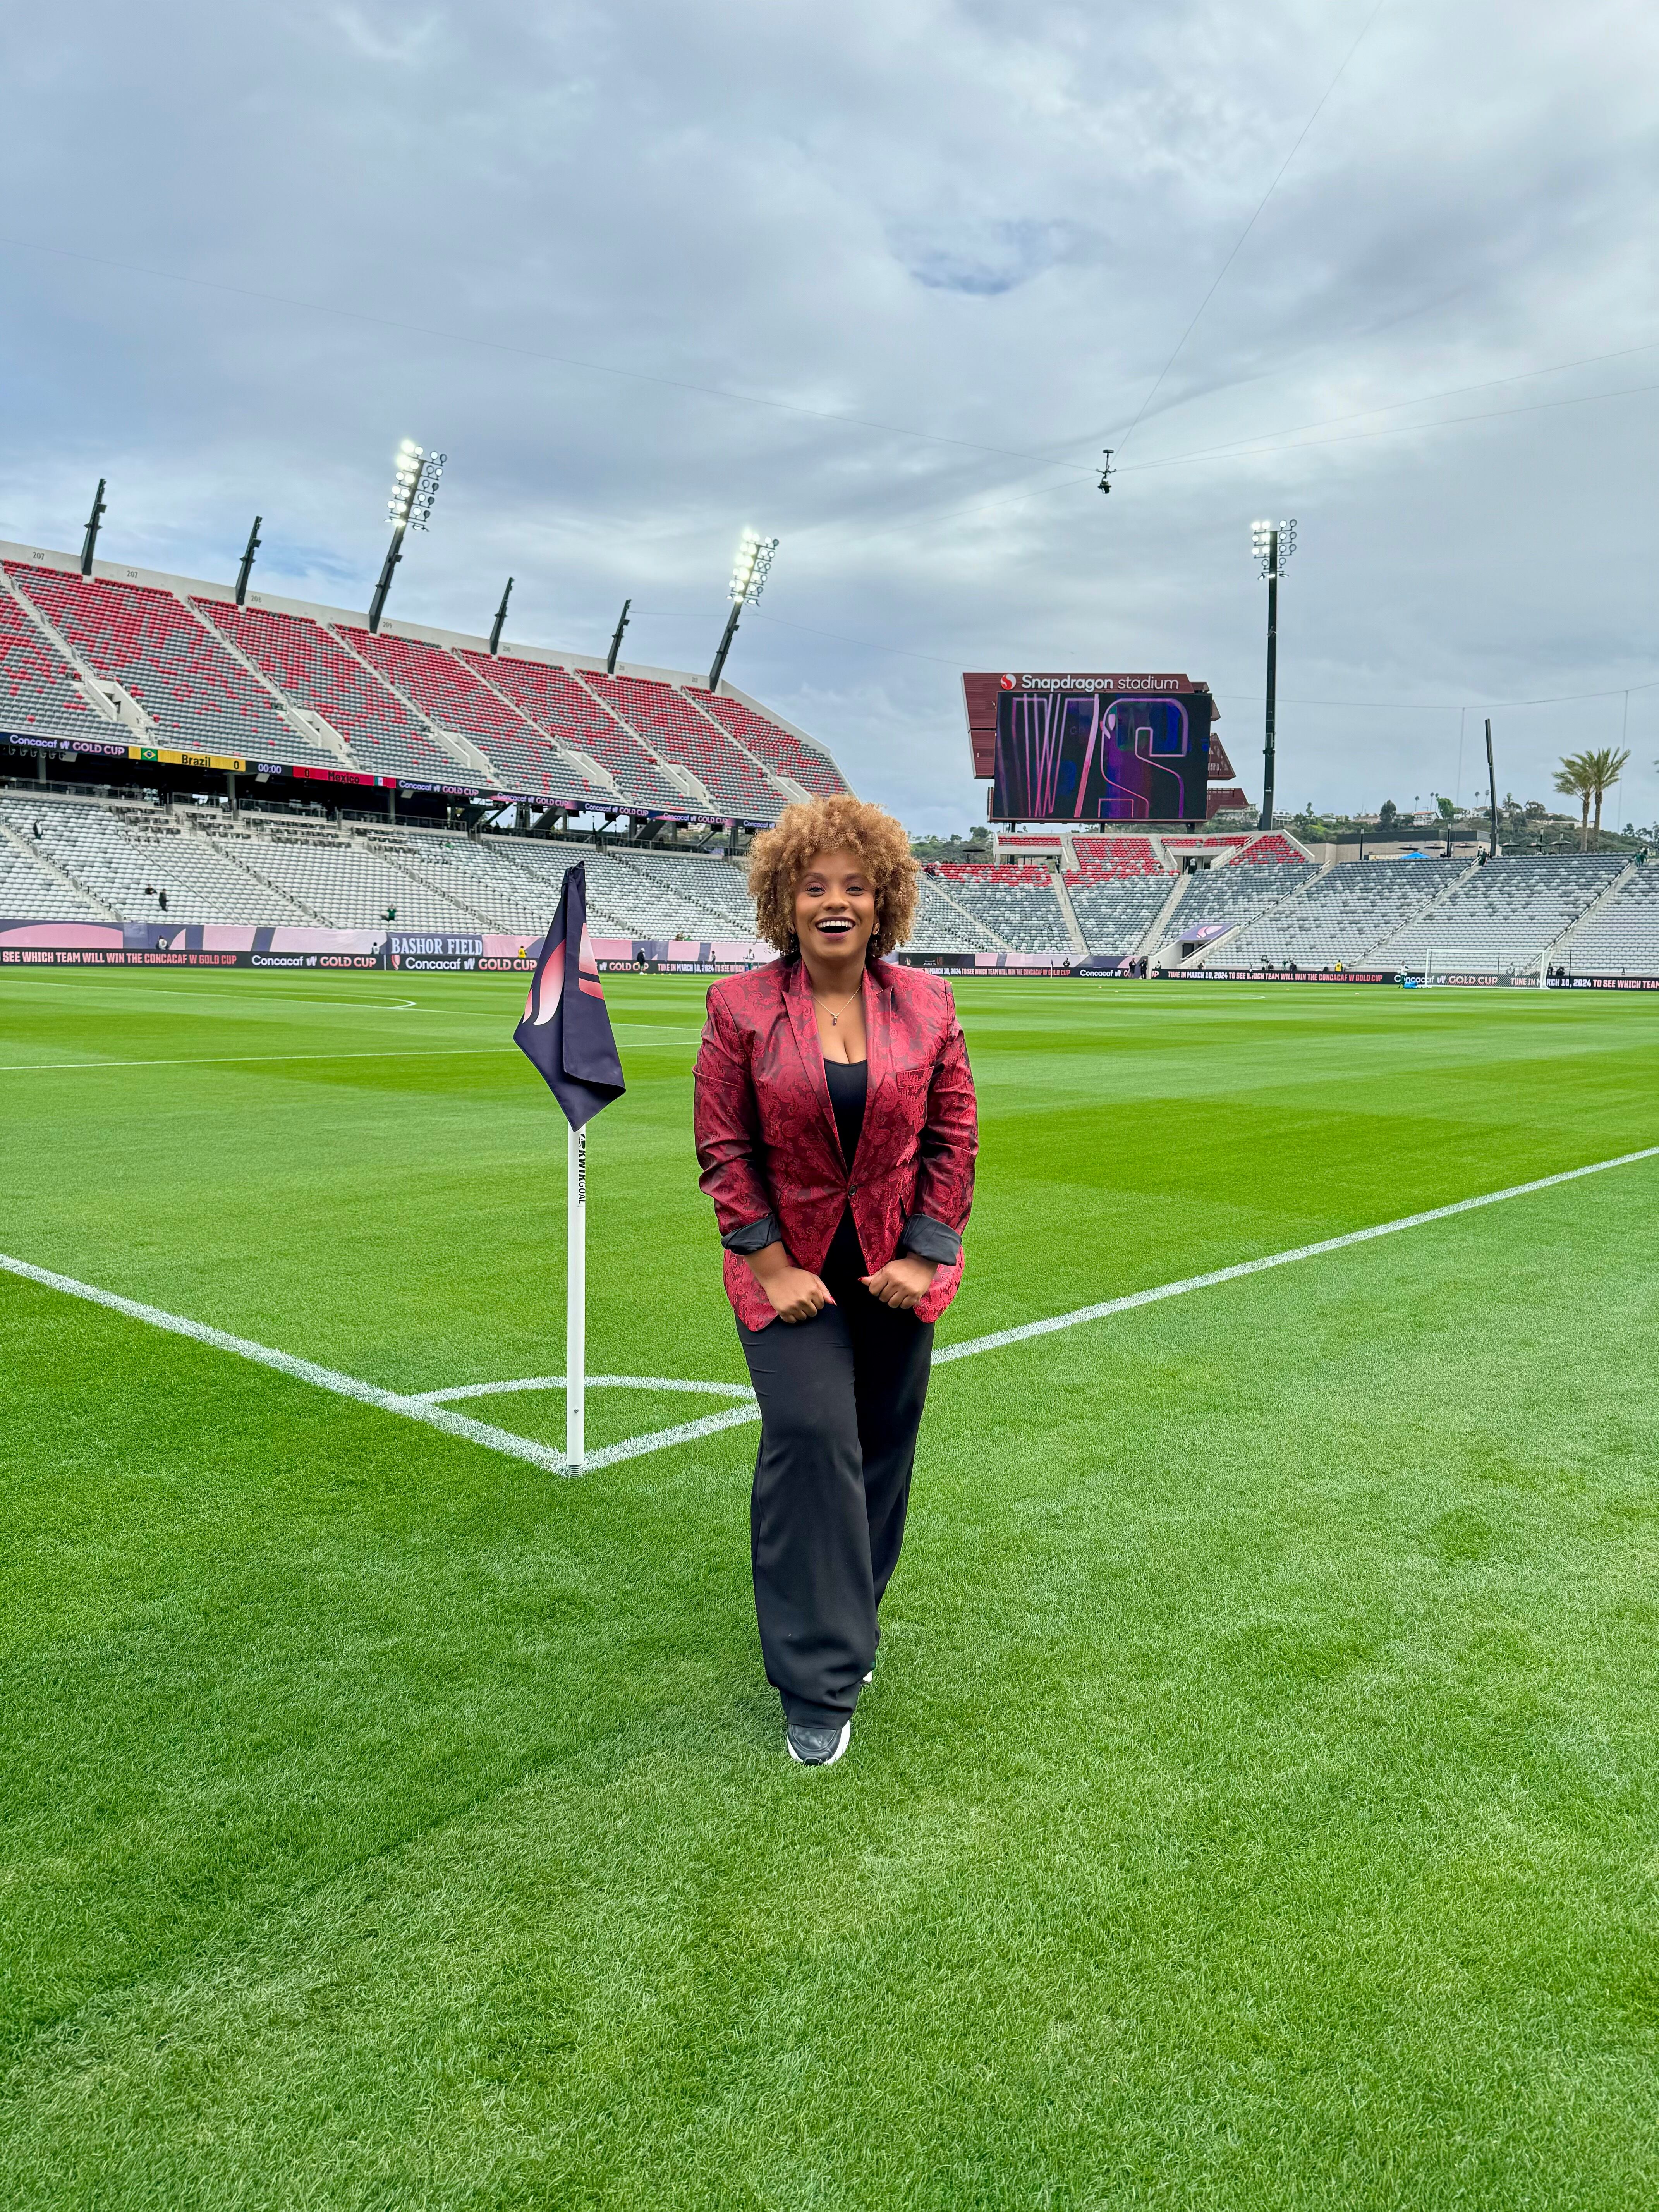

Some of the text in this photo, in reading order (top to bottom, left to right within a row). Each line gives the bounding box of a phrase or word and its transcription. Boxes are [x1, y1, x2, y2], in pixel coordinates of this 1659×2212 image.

[33, 551, 45, 560] 207
[126, 570, 138, 579] 207
[1021, 675, 1179, 692] Snapdragon stadium
[10, 734, 58, 748] Concacaf
[72, 742, 102, 754] GOLD
[103, 745, 125, 756] CUP
[182, 754, 211, 767] Brazil
[234, 760, 239, 769] 0
[258, 763, 282, 774] 00:00
[328, 771, 360, 784] Mexico
[398, 780, 432, 791] Concacaf
[442, 785, 463, 794] GOLD
[464, 788, 479, 796] CUP
[536, 797, 554, 805] GOLD
[619, 807, 636, 815] GOLD
[391, 937, 483, 955] BASHOR FIELD
[2, 951, 20, 963] SEE
[22, 951, 54, 963] WHICH
[55, 952, 81, 963] TEAM
[82, 952, 105, 963] WILL
[106, 953, 125, 963] WIN
[126, 953, 143, 963] THE
[144, 953, 187, 964] CONCACAF
[189, 954, 197, 964] W
[199, 955, 219, 964] GOLD
[221, 955, 237, 965] CUP
[251, 955, 377, 967] Concacaf W GOLD CUP
[405, 957, 538, 971] Concacaf W GOLD CUP
[599, 962, 607, 970] W
[609, 962, 632, 971] GOLD
[1448, 976, 1476, 984] GOLD
[1477, 976, 1498, 985] CUP
[1561, 979, 1572, 988] 10,
[1573, 979, 1592, 987] 2024
[1593, 979, 1602, 988] TO
[1603, 979, 1616, 988] SEE
[1617, 980, 1641, 988] WHICH
[1642, 980, 1659, 989] TEAM
